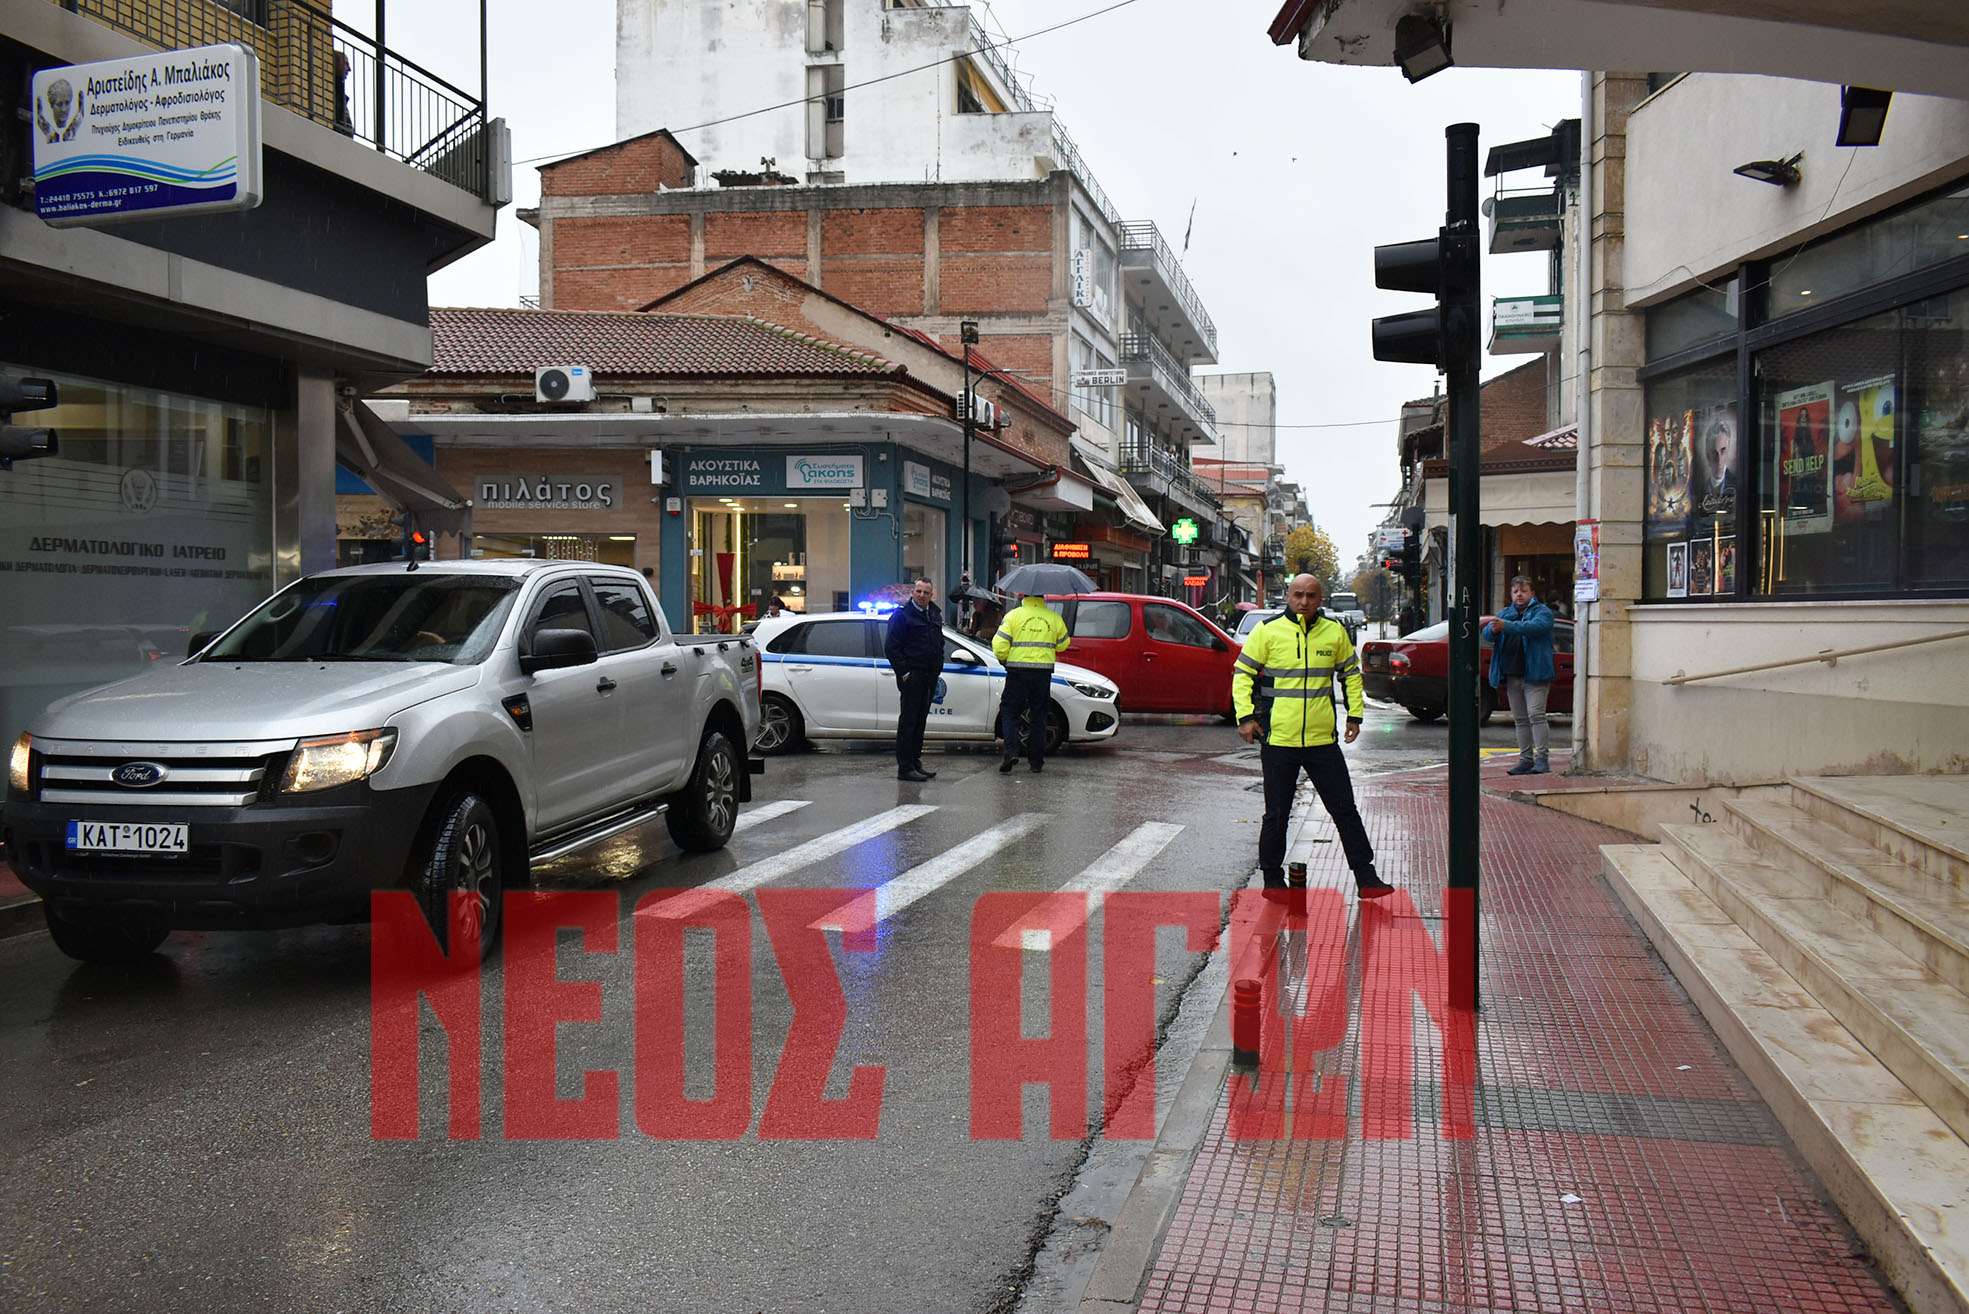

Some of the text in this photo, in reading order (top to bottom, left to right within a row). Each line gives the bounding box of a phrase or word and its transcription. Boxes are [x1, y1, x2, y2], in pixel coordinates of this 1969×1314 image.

[87, 58, 230, 99] Αριστείδης Α. Μπαλιάκος
[90, 97, 148, 117] Δερματολόγος
[155, 88, 225, 109] Αφροδισιολόγος
[153, 133, 164, 143] στη
[73, 191, 95, 200] 75575
[129, 185, 141, 194] 817
[144, 184, 158, 193] 597
[1092, 376, 1124, 384] BERLIN
[689, 460, 761, 471] ΑΚΟΥΣΤΙΚΑ
[1783, 454, 1825, 476] SEND HELP
[689, 473, 761, 486] ΒΑΡΗΚΟΪΑΣ
[481, 476, 612, 506] πιλάτος
[488, 500, 601, 510] mobile service store
[29, 537, 226, 561] ΔΕΡΜΑΤΟΛΟΓΙΚΟ ΙΑΤΡΕΙΟ
[121, 766, 151, 780] Ford
